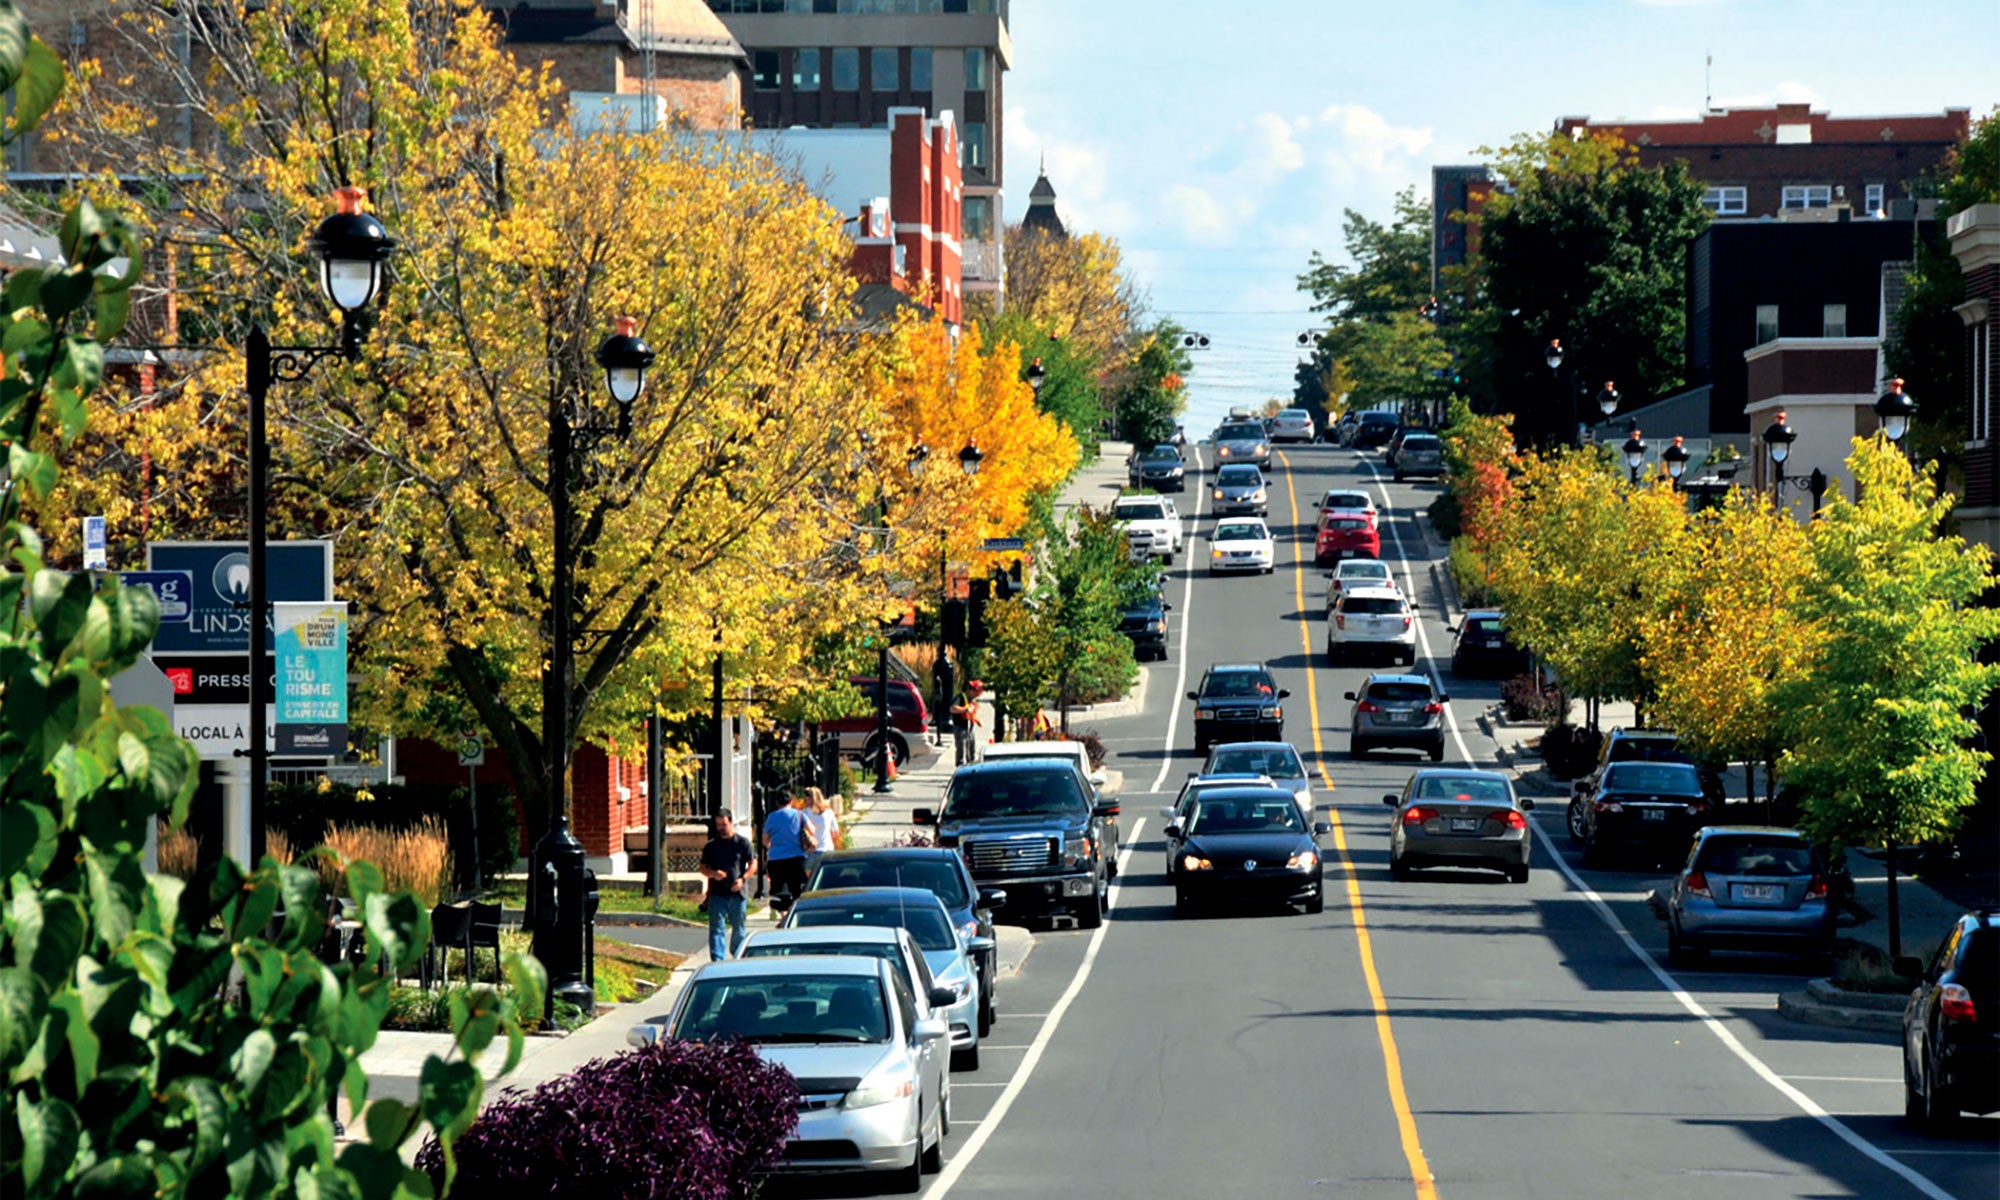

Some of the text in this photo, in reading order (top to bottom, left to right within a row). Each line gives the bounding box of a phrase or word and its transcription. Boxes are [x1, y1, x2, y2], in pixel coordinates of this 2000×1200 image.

[307, 623, 335, 631] DRUM
[307, 639, 335, 647] VILLE
[285, 655, 304, 668] LE
[285, 670, 316, 682] TOU
[286, 683, 331, 696] RISME
[285, 710, 339, 719] CAPITALE
[181, 723, 244, 740] LOCAL À
